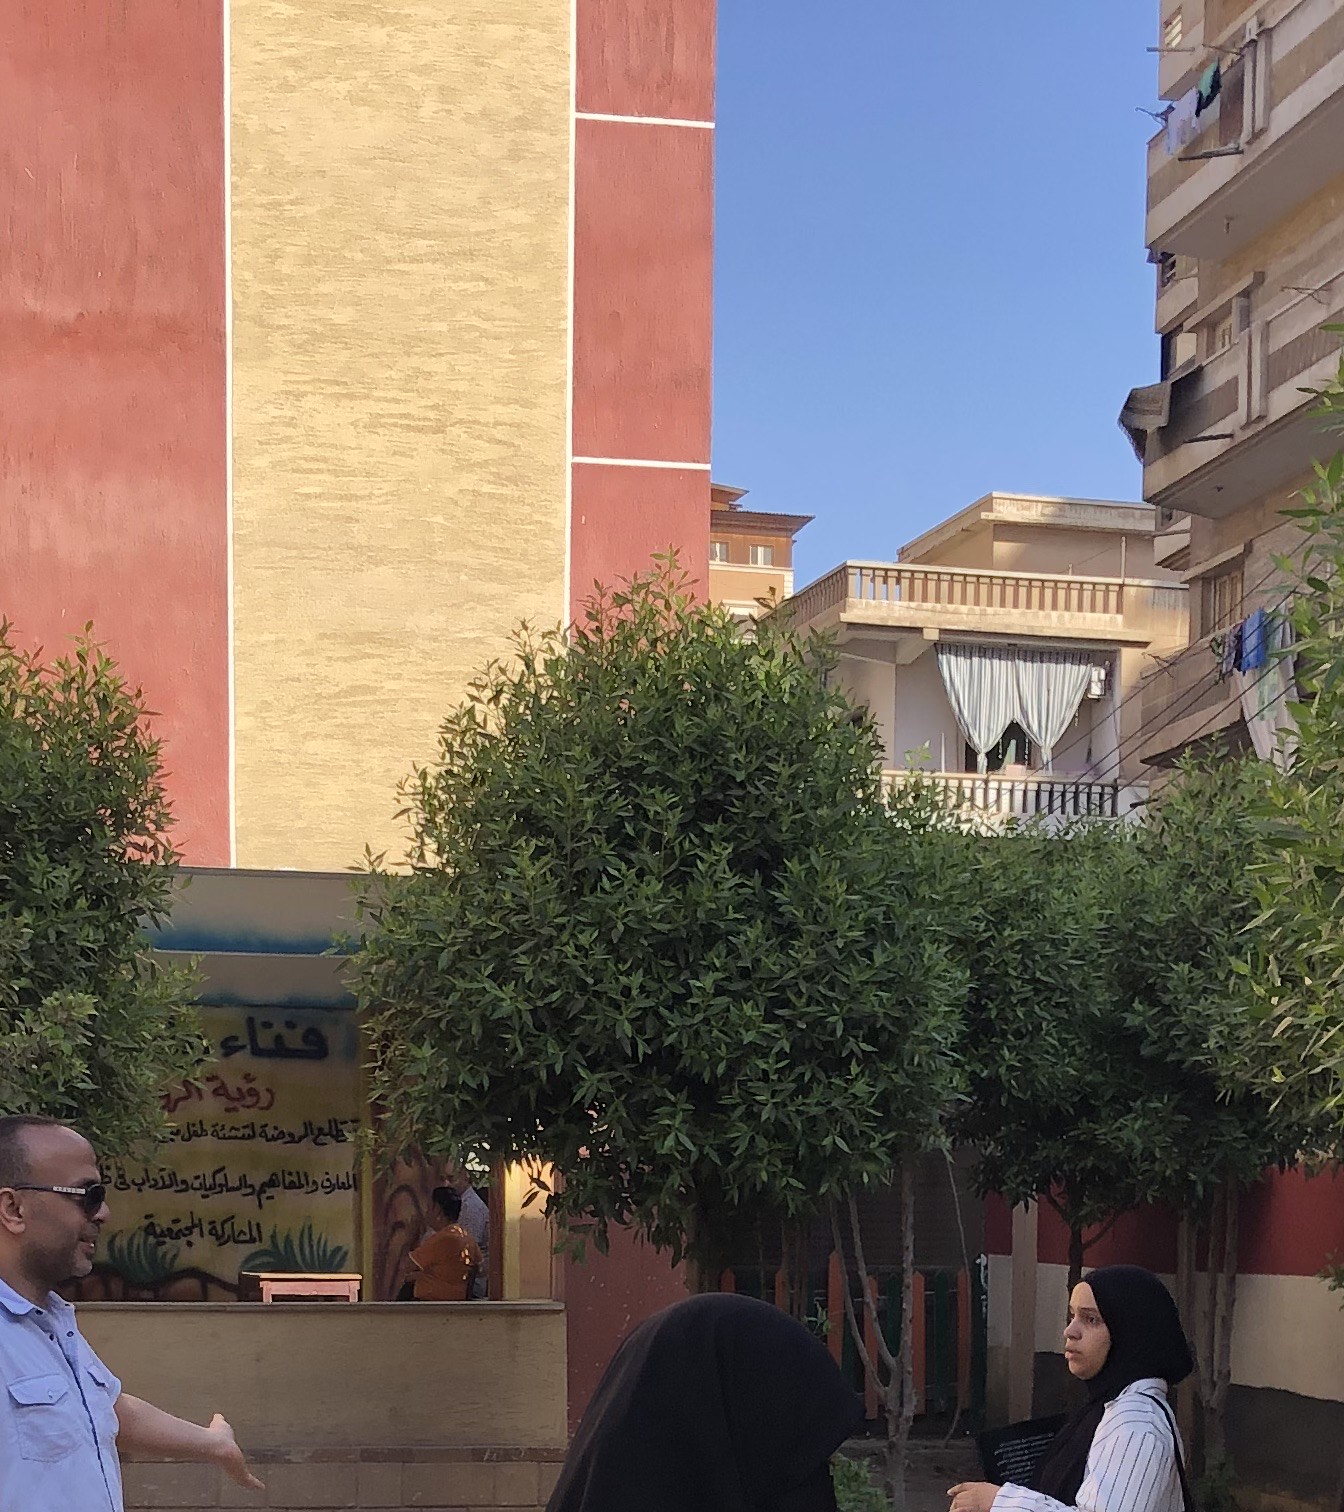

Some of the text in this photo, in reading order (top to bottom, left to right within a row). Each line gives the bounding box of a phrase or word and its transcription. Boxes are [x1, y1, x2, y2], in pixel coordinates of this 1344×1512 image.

[219, 1015, 331, 1060] فناء
[180, 1119, 209, 1142] طفل
[258, 1119, 316, 1145] الروضة
[256, 1168, 319, 1211] والمفاهيم
[320, 1171, 358, 1195] المعارف
[143, 1210, 263, 1248] المشاركة المجتمعية
